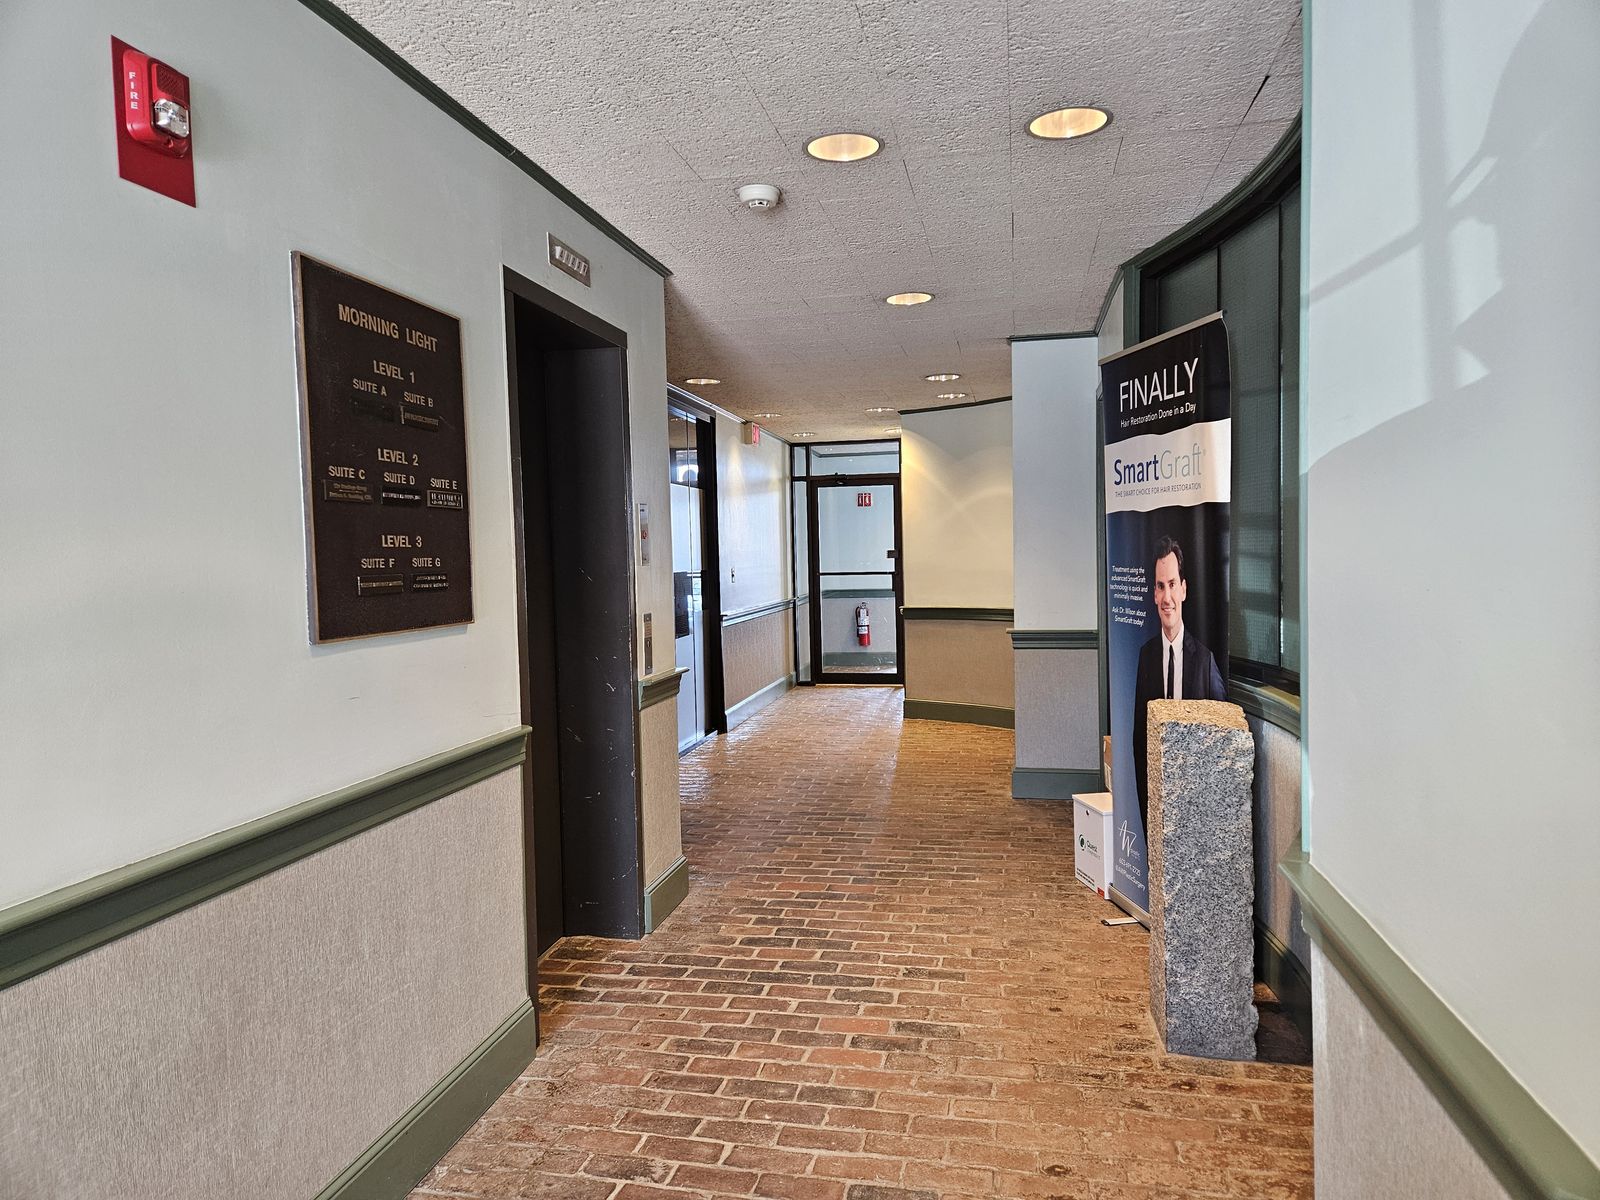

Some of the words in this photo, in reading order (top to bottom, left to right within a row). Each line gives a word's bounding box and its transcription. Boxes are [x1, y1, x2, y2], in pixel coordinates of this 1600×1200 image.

[128, 71, 139, 109] FIRE
[338, 303, 400, 339] MORNING
[406, 327, 438, 352] LIGHT
[373, 360, 404, 382] LEVEL
[409, 371, 415, 383] 1
[352, 378, 378, 396] SUITE
[380, 385, 387, 397] A
[1119, 357, 1199, 413] FINALLY
[404, 391, 426, 406] SUITE
[428, 396, 434, 408] B
[1120, 418, 1130, 428] Hair
[1130, 412, 1158, 426] Restoration
[1158, 409, 1173, 419] Done
[1173, 406, 1179, 415] in
[1180, 406, 1184, 414] a
[1185, 402, 1197, 414] Day
[378, 448, 409, 464] LEVEL
[412, 454, 419, 466] 2
[328, 465, 355, 479] SUITE
[358, 469, 366, 480] C
[384, 472, 407, 484] SUITE
[410, 475, 416, 485] D
[430, 478, 450, 489] SUITE
[452, 480, 458, 490] E
[1123, 489, 1136, 497] SMART
[1136, 488, 1151, 496] CHOICE
[1151, 487, 1160, 495] FOR
[1171, 482, 1202, 492] RESTORATION
[381, 534, 413, 548] LEVEL
[416, 534, 422, 548] 3
[361, 558, 385, 568] SUITE
[389, 558, 395, 568] F
[412, 558, 433, 568] SUITE
[435, 558, 441, 567] G
[1112, 565, 1129, 573] Treatment
[1130, 566, 1138, 575] using
[1111, 574, 1128, 582] advanced
[1128, 575, 1146, 583] SmartGraft
[1110, 583, 1128, 592] technology
[1132, 585, 1141, 593] quick
[1114, 592, 1129, 602] minimally
[1114, 615, 1133, 623] SmartGraft
